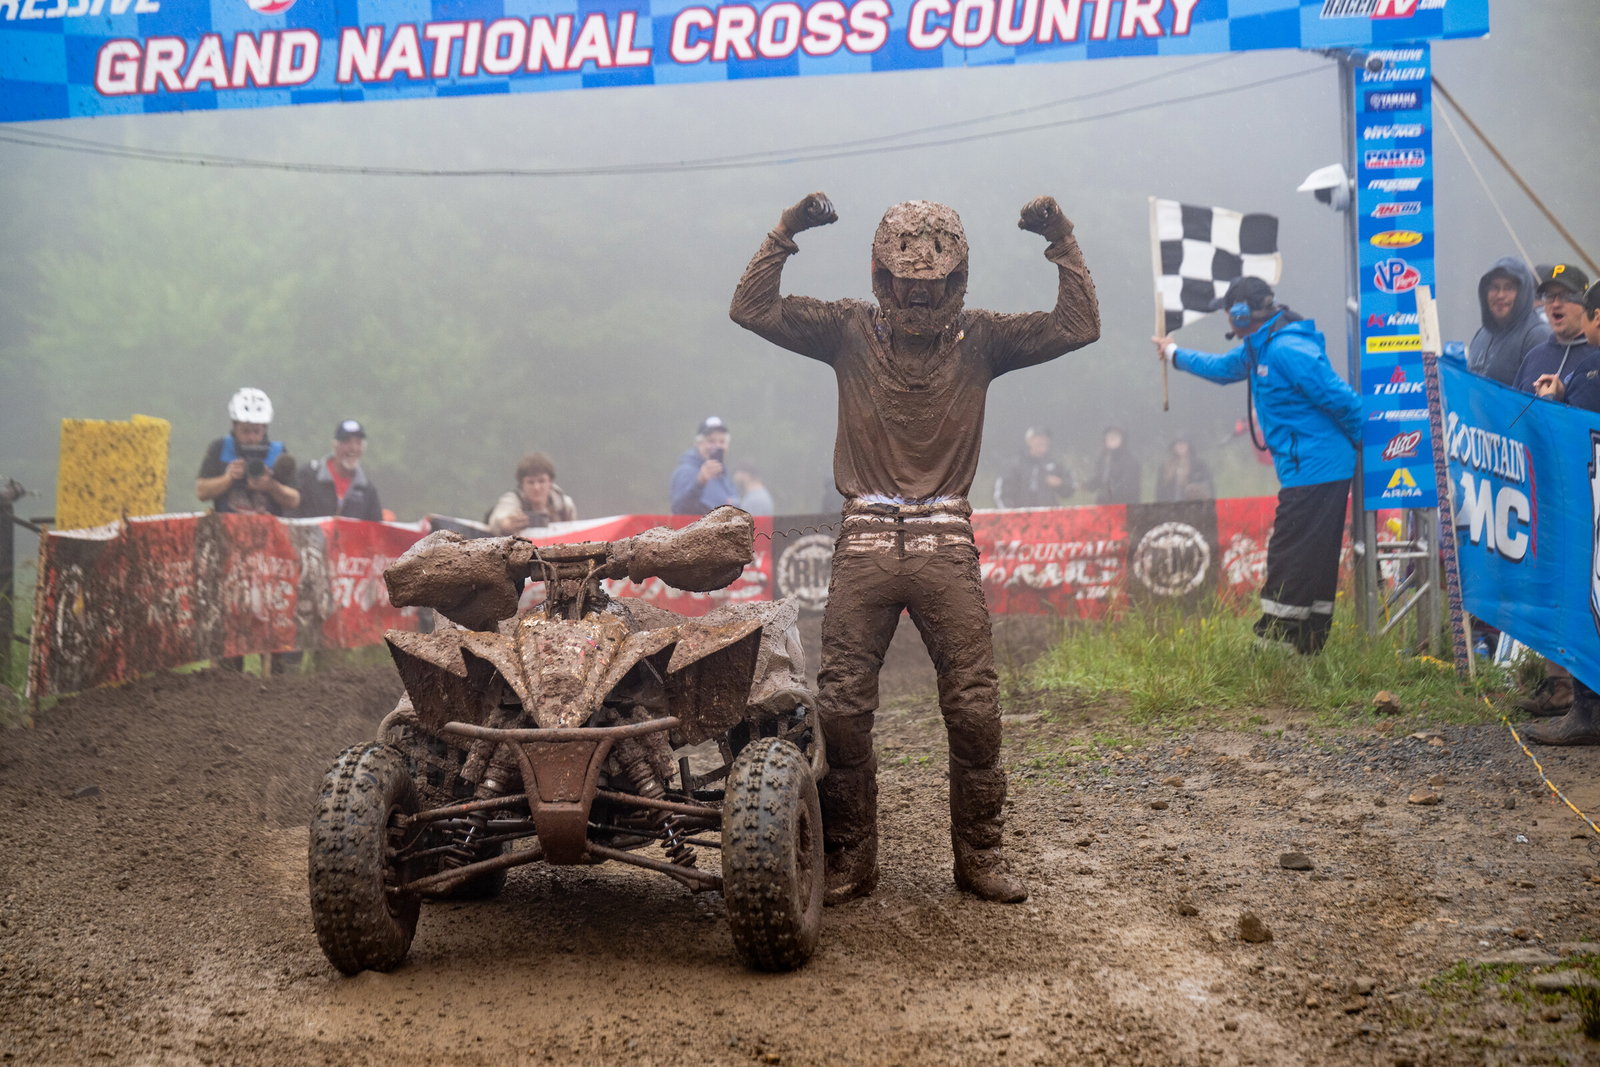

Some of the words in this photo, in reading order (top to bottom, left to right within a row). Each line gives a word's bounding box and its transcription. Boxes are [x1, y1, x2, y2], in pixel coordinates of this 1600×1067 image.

[95, 29, 320, 96] GRAND
[337, 12, 654, 84] NATIONAL
[671, 0, 890, 62] CROSS
[907, 0, 1200, 50] COUNTRY
[1380, 93, 1416, 105] YAMAHA
[1552, 264, 1566, 279] P
[1387, 313, 1419, 326] KEN
[1379, 339, 1421, 348] DUNLO
